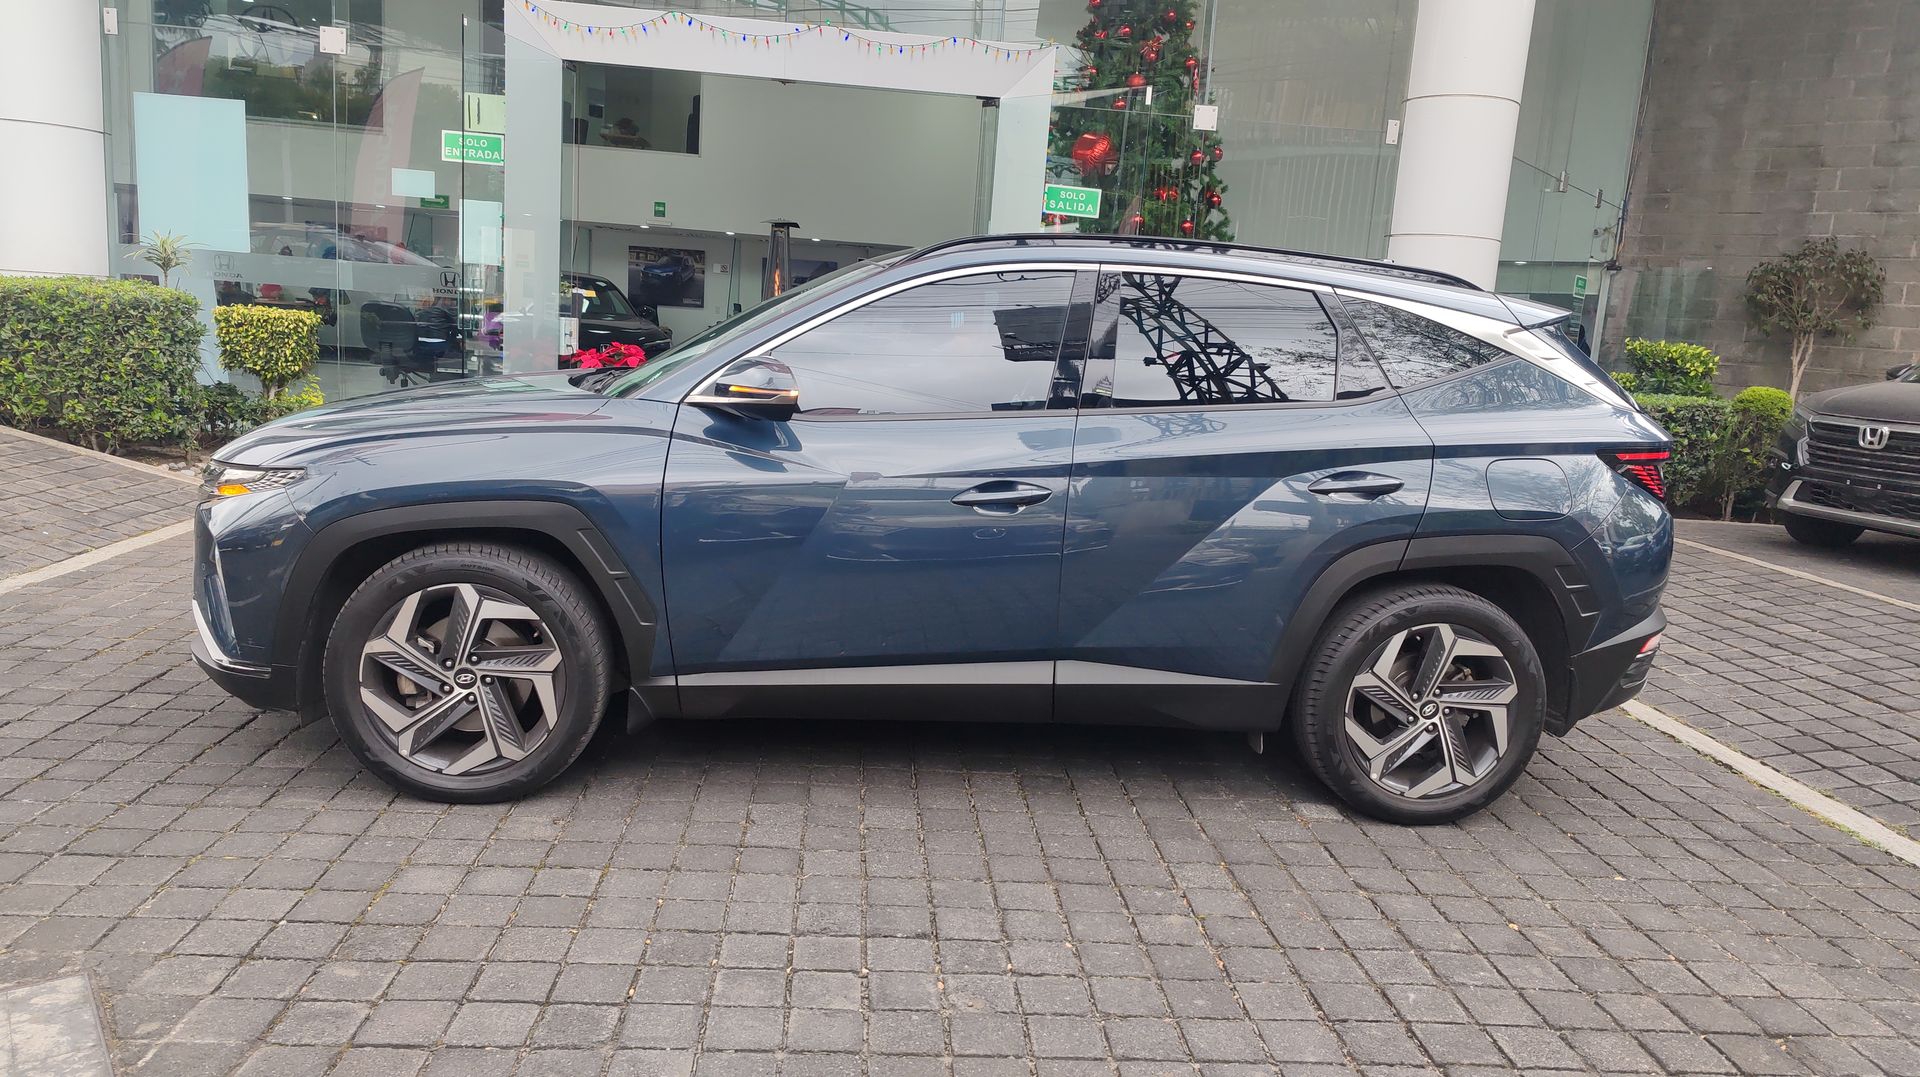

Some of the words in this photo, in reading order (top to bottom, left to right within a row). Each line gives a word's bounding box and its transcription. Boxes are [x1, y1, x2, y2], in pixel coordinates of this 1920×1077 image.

[458, 137, 488, 147] SOLO
[445, 147, 500, 159] ENTRADA
[1059, 190, 1086, 200] SOLO
[1049, 199, 1094, 213] SALIDA
[431, 287, 465, 295] HOND
